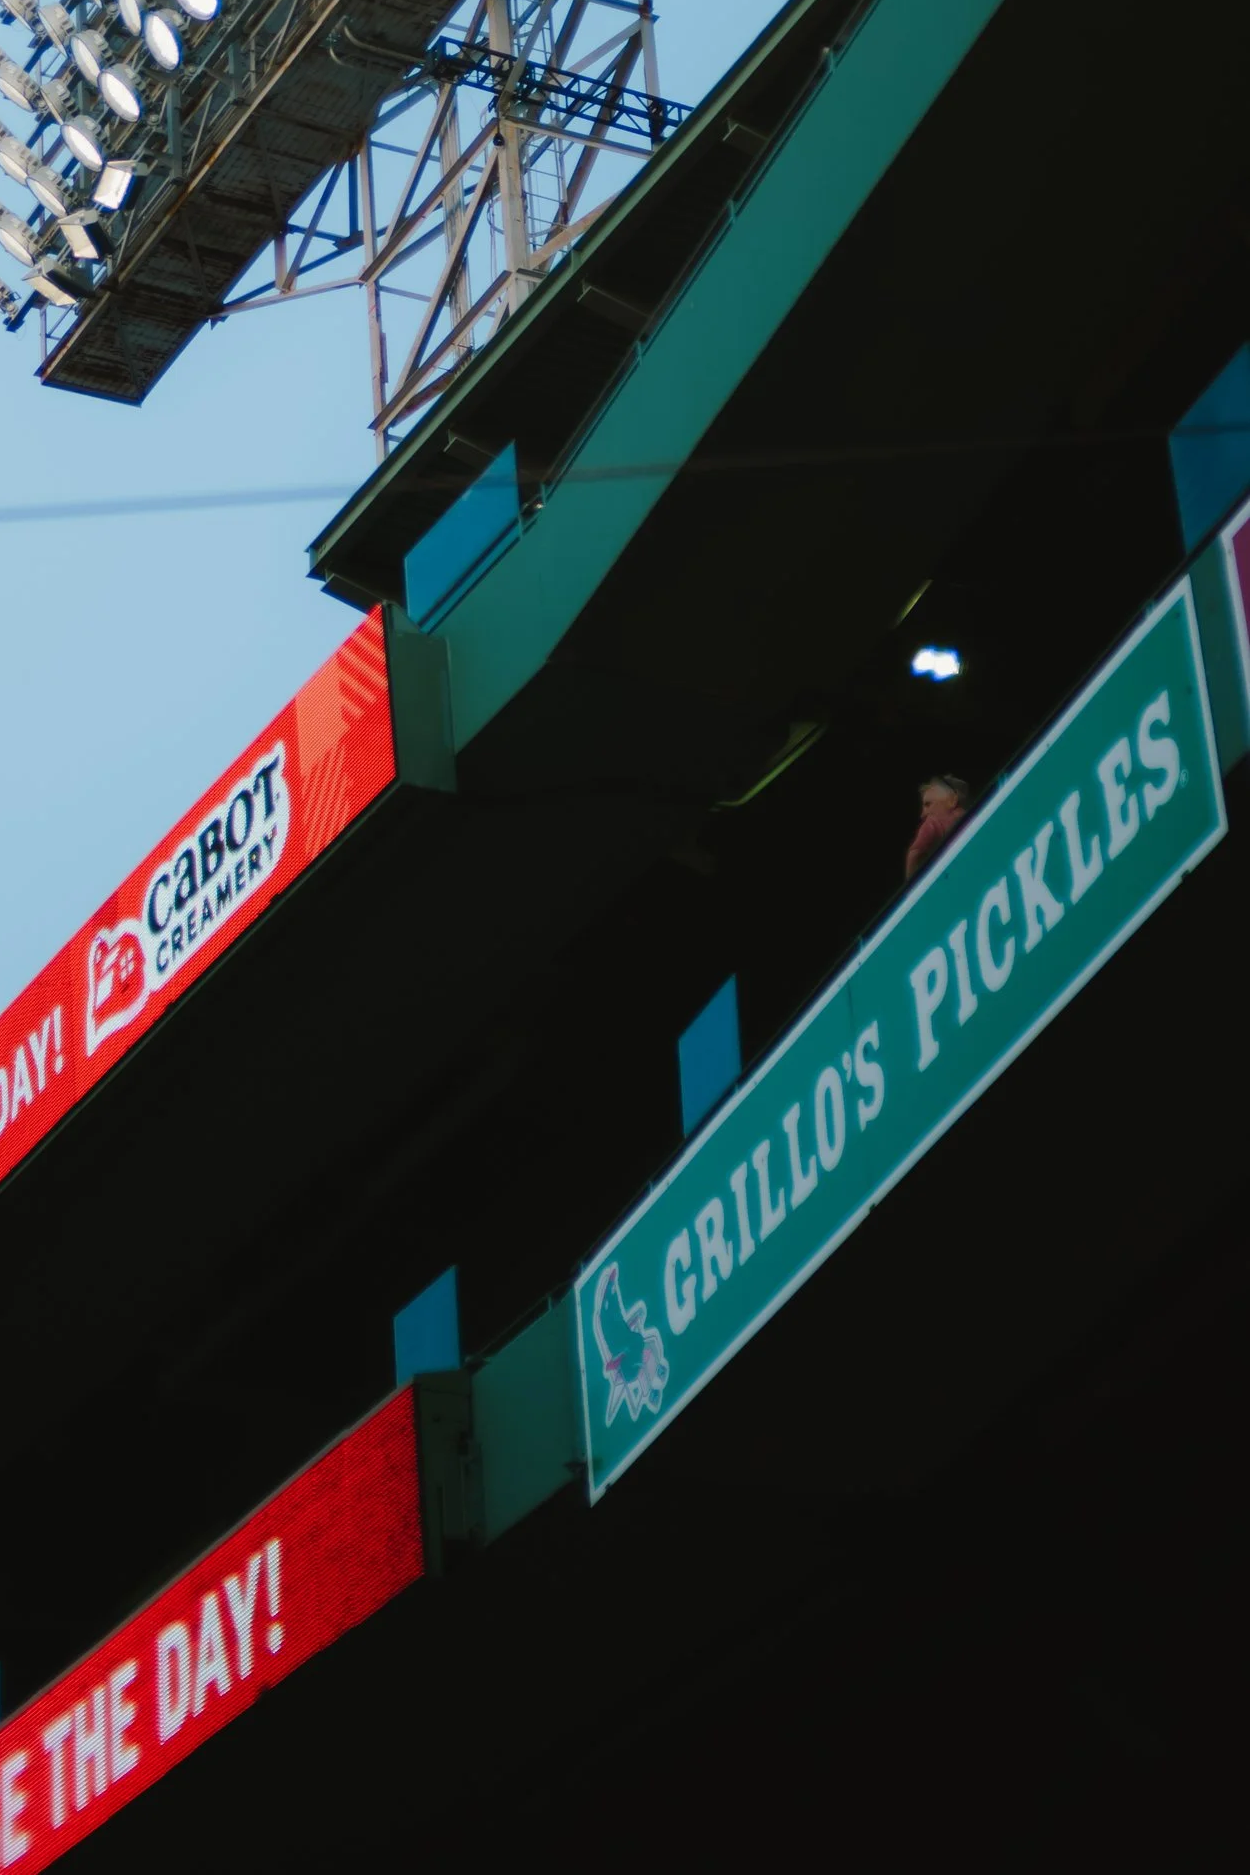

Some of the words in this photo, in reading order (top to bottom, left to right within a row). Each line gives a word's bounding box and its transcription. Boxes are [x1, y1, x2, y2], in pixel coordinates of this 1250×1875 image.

[156, 824, 278, 975] CREAMERY
[664, 1019, 885, 1336] GRILLO'S
[909, 688, 1181, 1073] PICKLES
[42, 1659, 141, 1830] THE
[155, 1536, 284, 1746] DAY!
